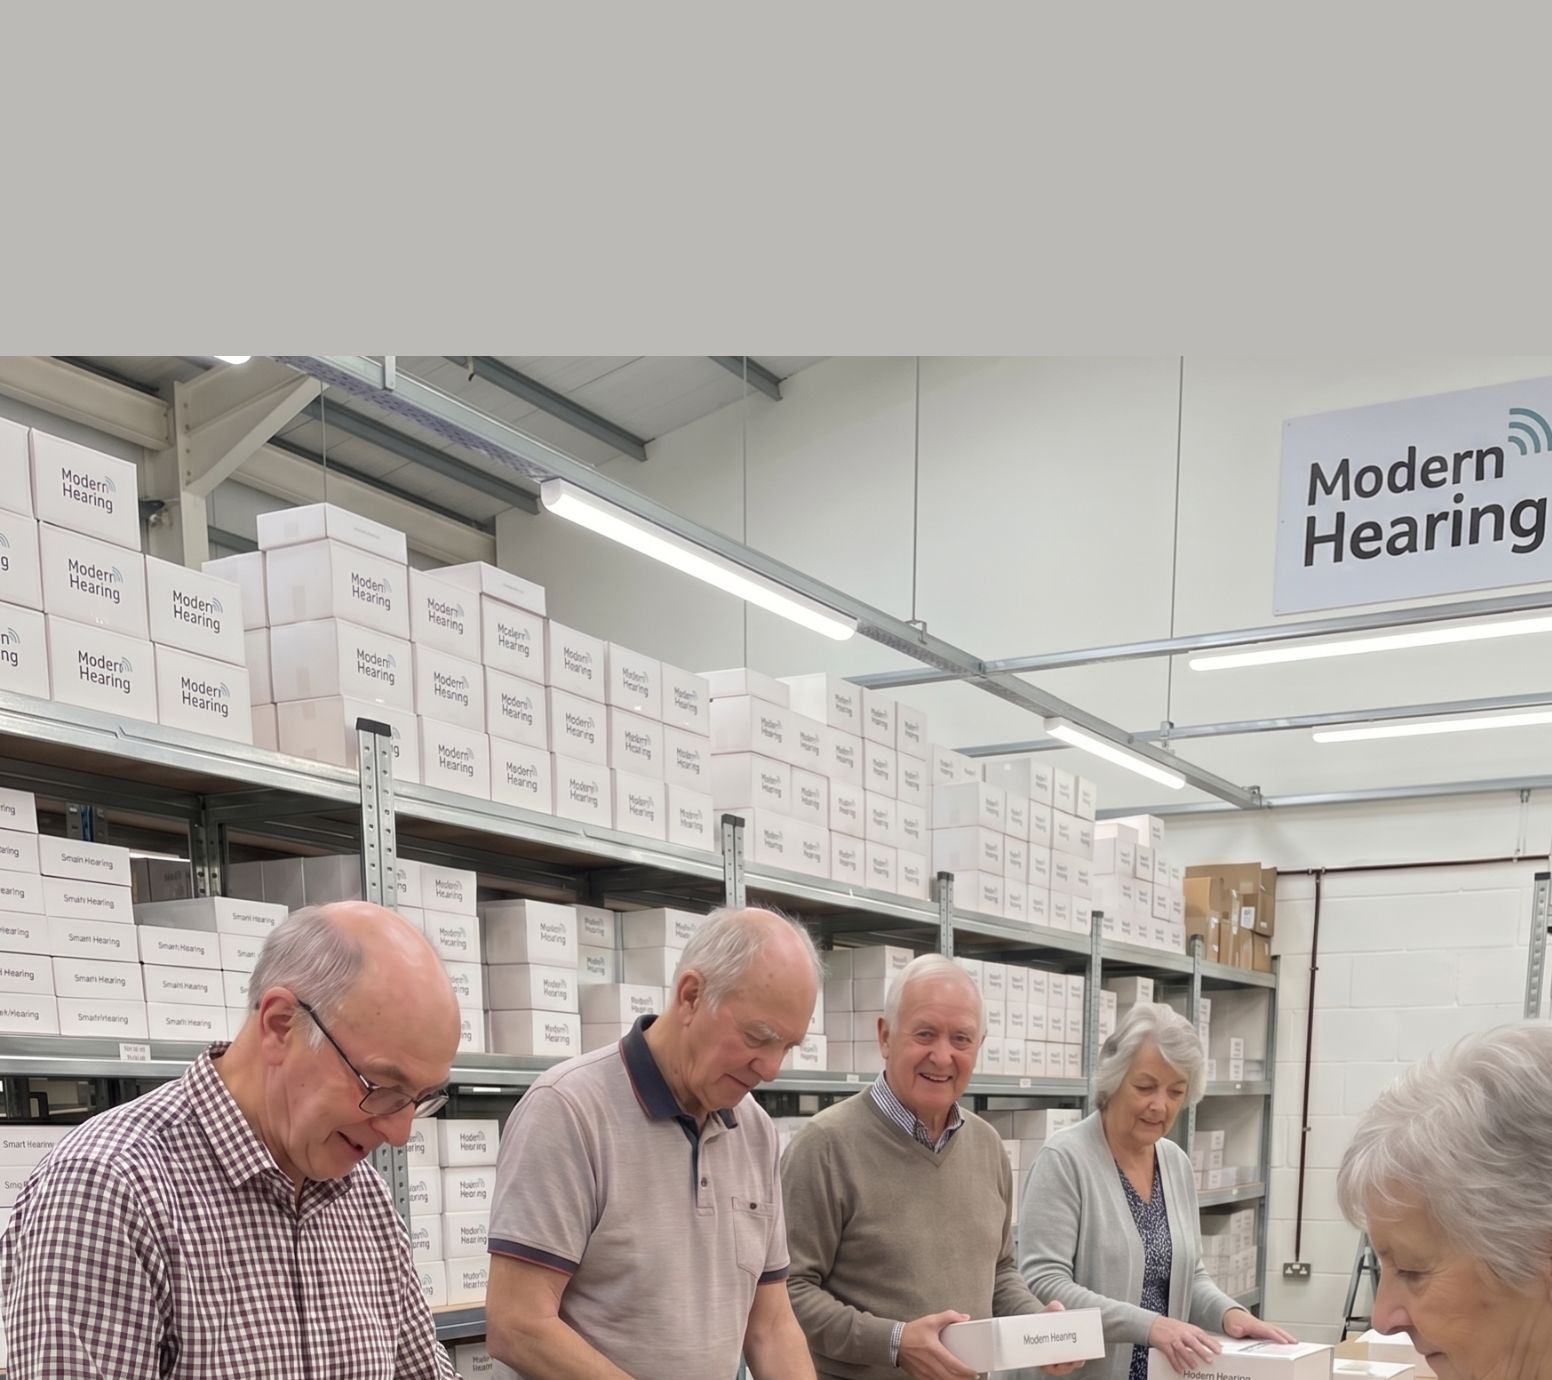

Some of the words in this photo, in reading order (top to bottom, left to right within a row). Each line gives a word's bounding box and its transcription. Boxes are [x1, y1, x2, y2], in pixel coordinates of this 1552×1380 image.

[62, 467, 109, 494] Modern
[1307, 446, 1504, 506] Modern
[62, 482, 113, 514] Hearing
[1304, 493, 1547, 567] Hearing
[69, 574, 120, 604] Hearing
[352, 585, 391, 611] Hearing
[173, 604, 220, 634] Hearing
[428, 611, 463, 635] Hearing
[79, 666, 131, 694] Hearing
[357, 661, 395, 686] Hearing
[182, 691, 229, 718] Hearing
[439, 757, 474, 777] Hearing
